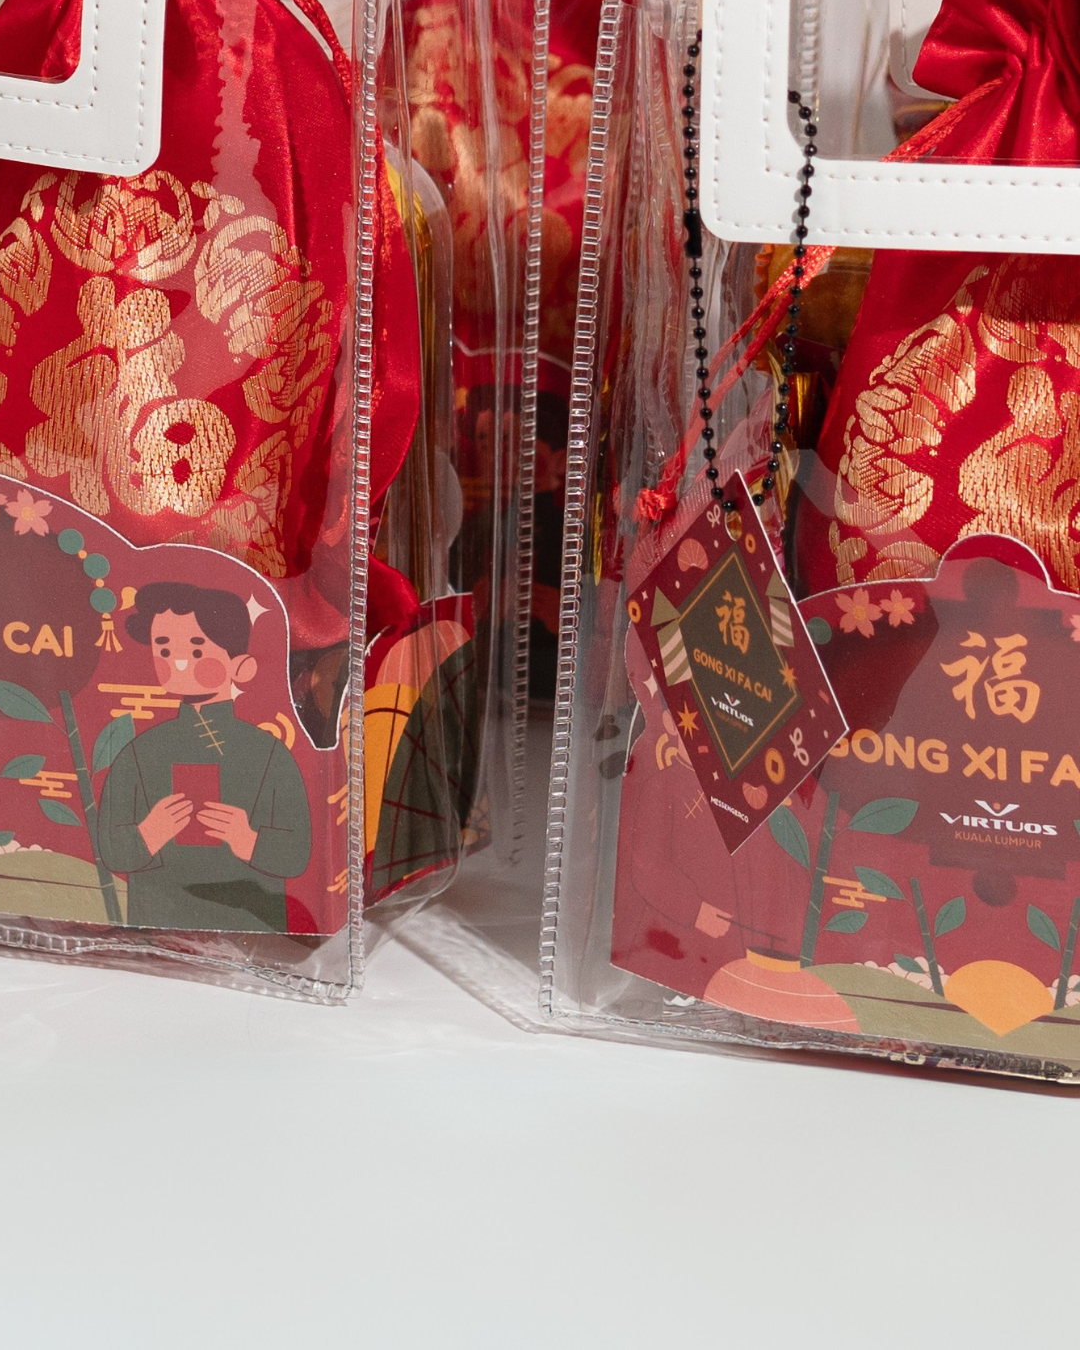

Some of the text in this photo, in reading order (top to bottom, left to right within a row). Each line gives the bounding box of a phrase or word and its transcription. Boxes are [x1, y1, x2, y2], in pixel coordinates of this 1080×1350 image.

[3, 621, 74, 658] CAI
[715, 590, 750, 654] 福
[693, 647, 773, 703] GONG XI FA CAI
[939, 630, 1041, 723] 福
[710, 696, 754, 727] VIRTUOS
[961, 743, 1007, 781] XI
[939, 812, 1058, 836] VIRTUOS
[954, 830, 1042, 850] KUALA LUMPUR
